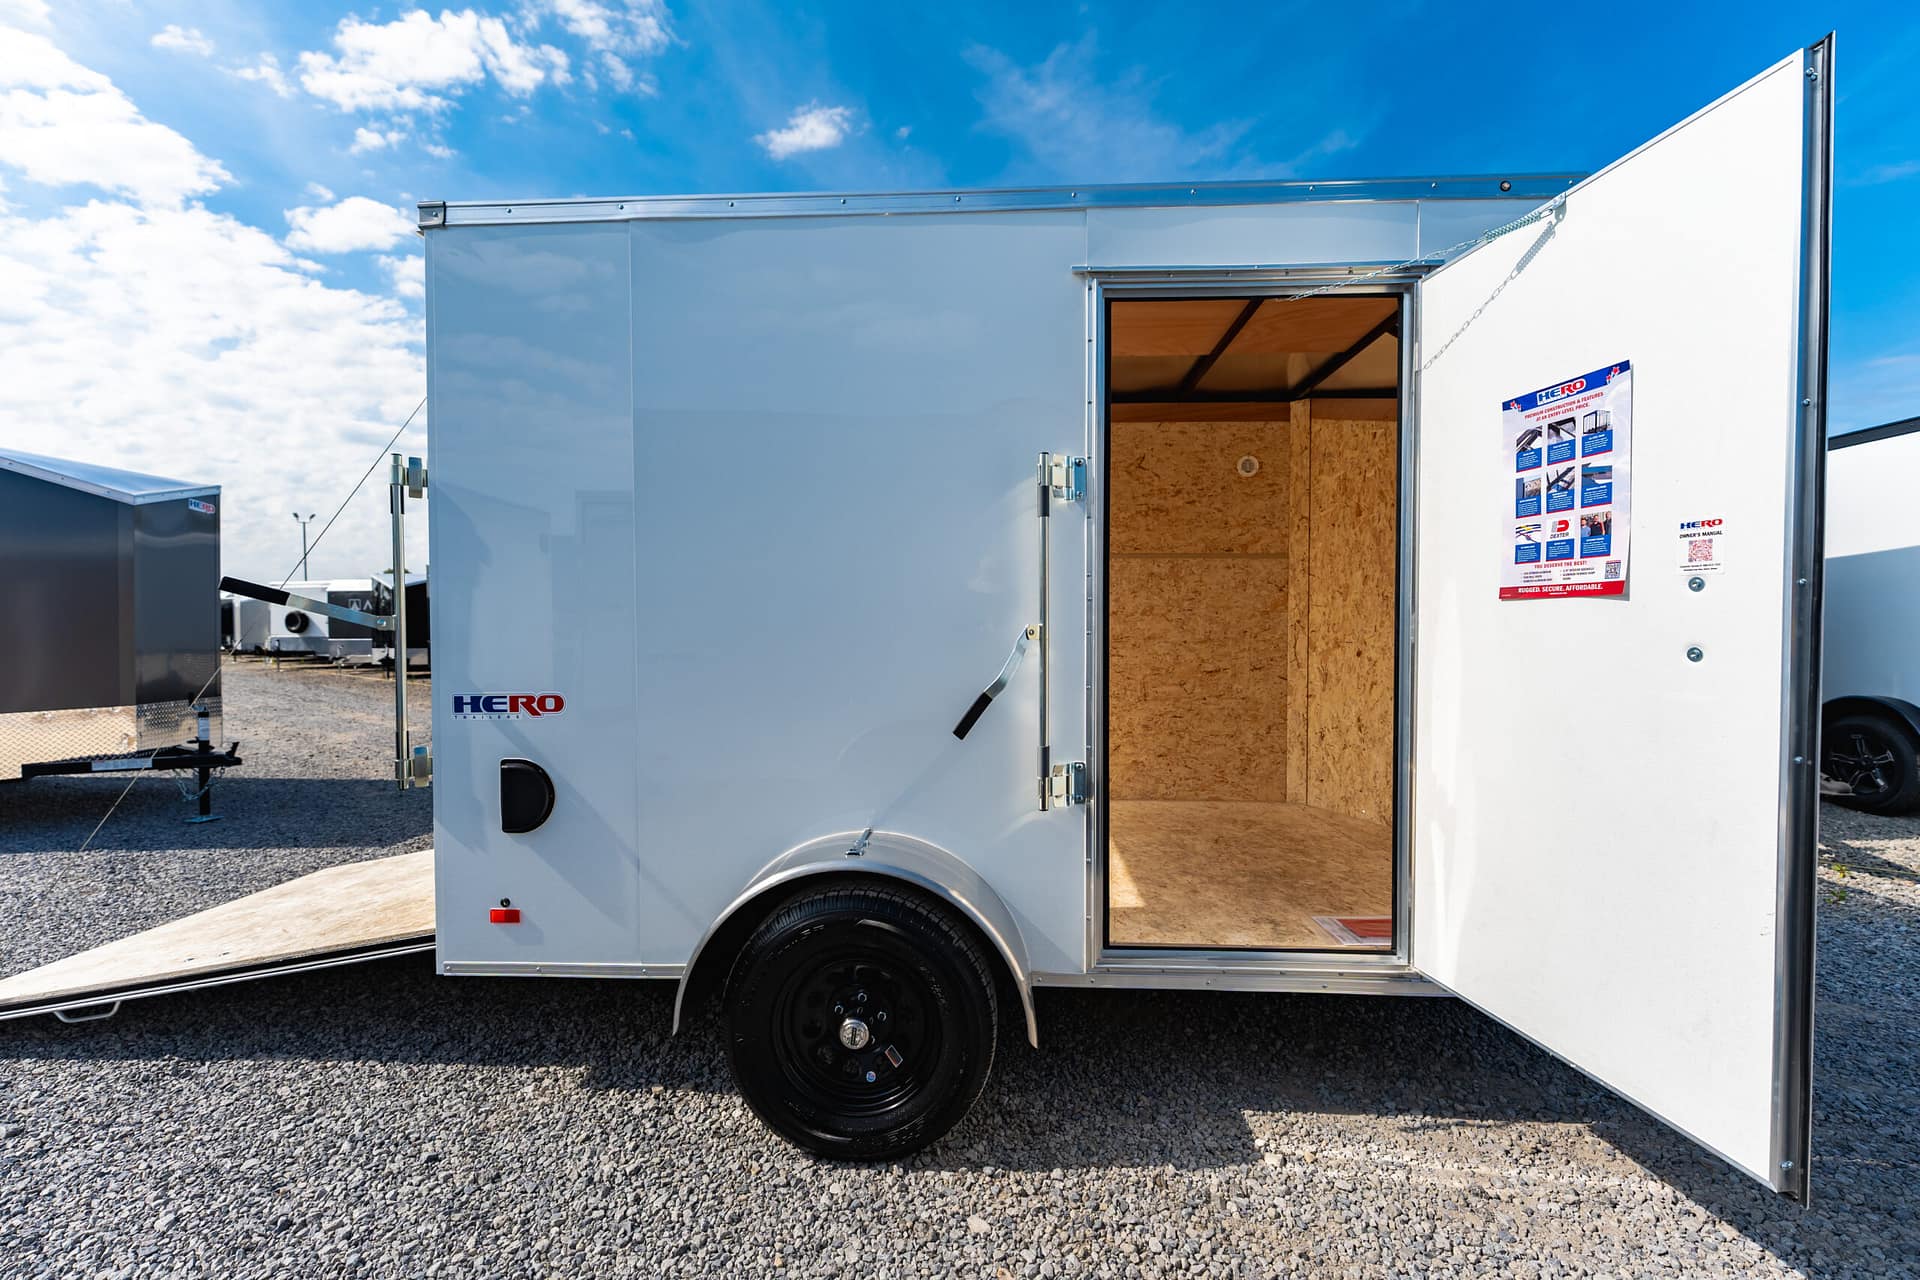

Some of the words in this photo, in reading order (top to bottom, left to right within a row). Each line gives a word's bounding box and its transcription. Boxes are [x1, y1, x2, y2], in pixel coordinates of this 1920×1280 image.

[1538, 379, 1585, 402] HERO
[1544, 401, 1576, 415] CONSTRUCTION
[1581, 391, 1604, 403] FEATURES
[1561, 407, 1575, 415] LEVEL
[189, 500, 215, 513] HERO
[1680, 518, 1723, 530] HERO
[1549, 531, 1570, 540] DEXTER
[453, 694, 565, 717] HERO
